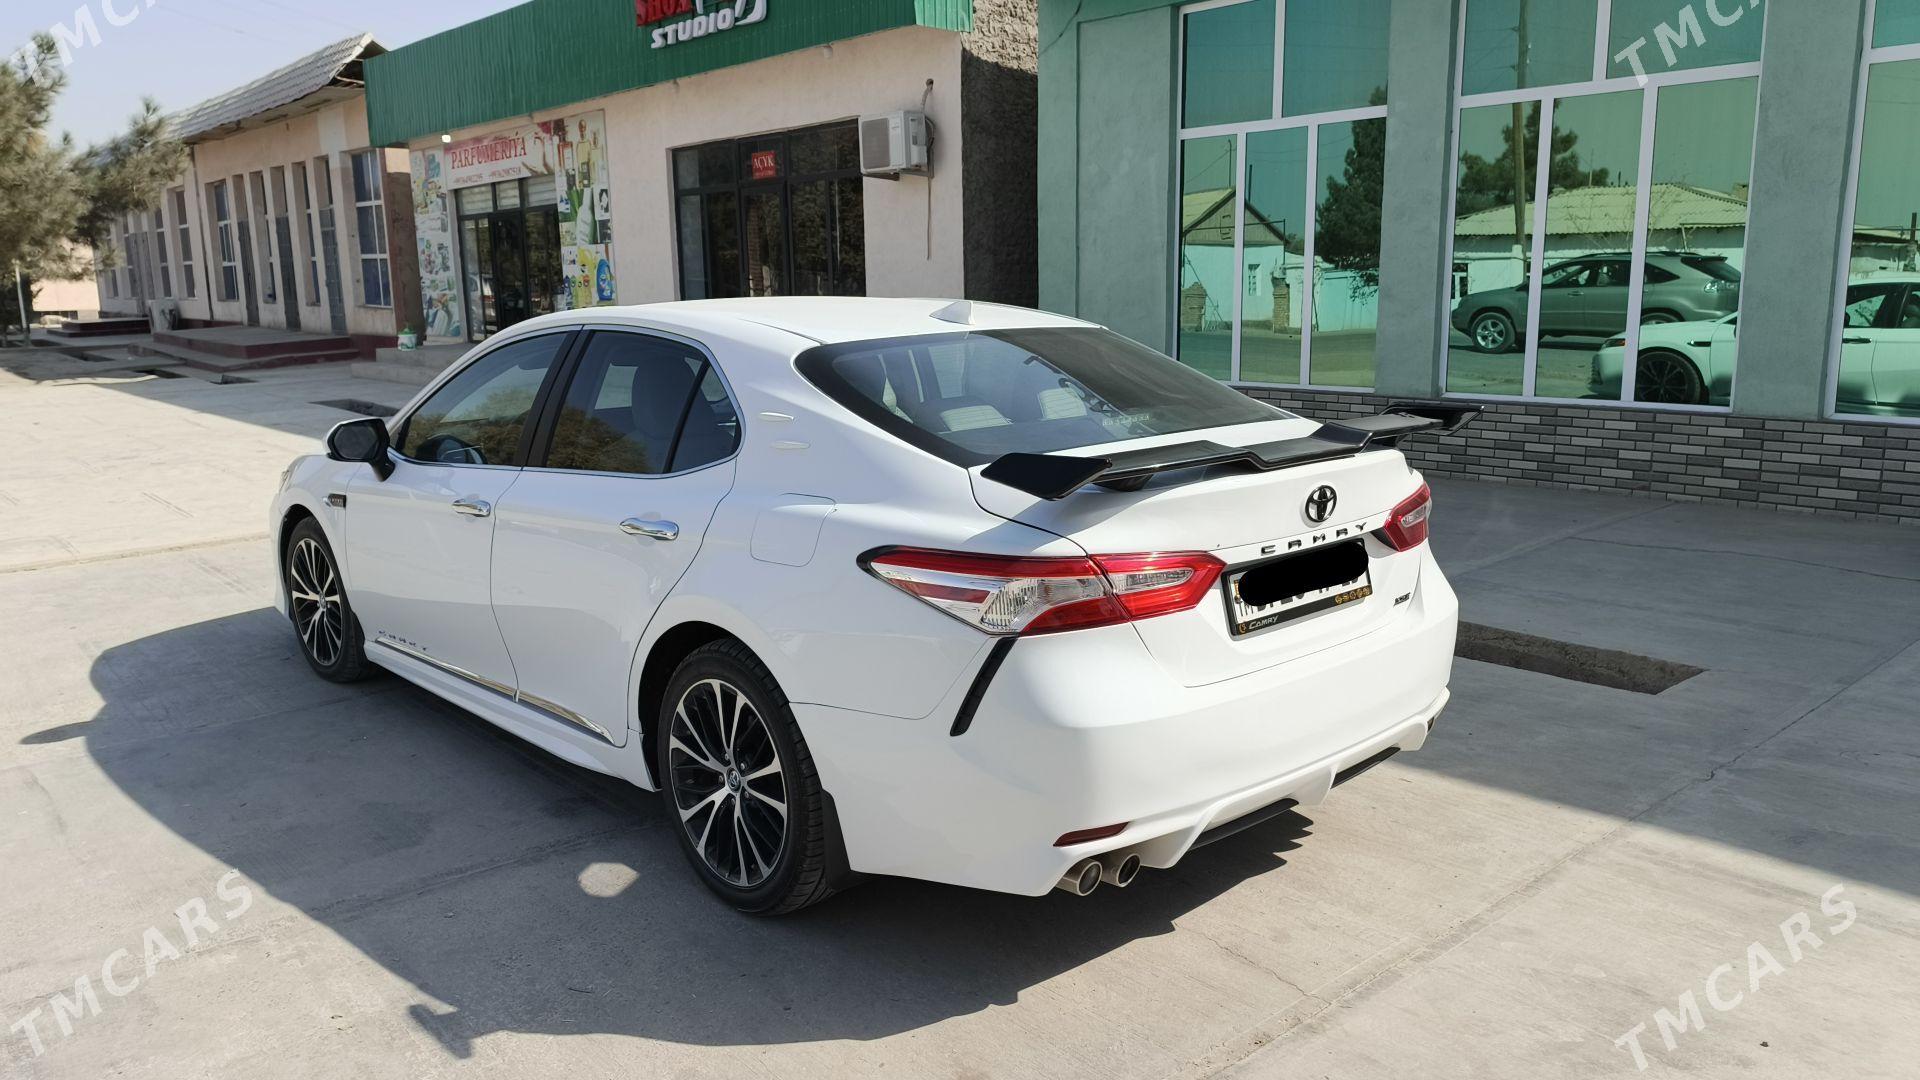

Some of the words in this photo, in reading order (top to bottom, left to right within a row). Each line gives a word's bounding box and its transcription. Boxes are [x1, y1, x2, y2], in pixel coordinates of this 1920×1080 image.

[651, 8, 735, 48] STUDIO
[451, 131, 527, 169] PARFUMERIÝA
[1261, 522, 1368, 556] CAMRY
